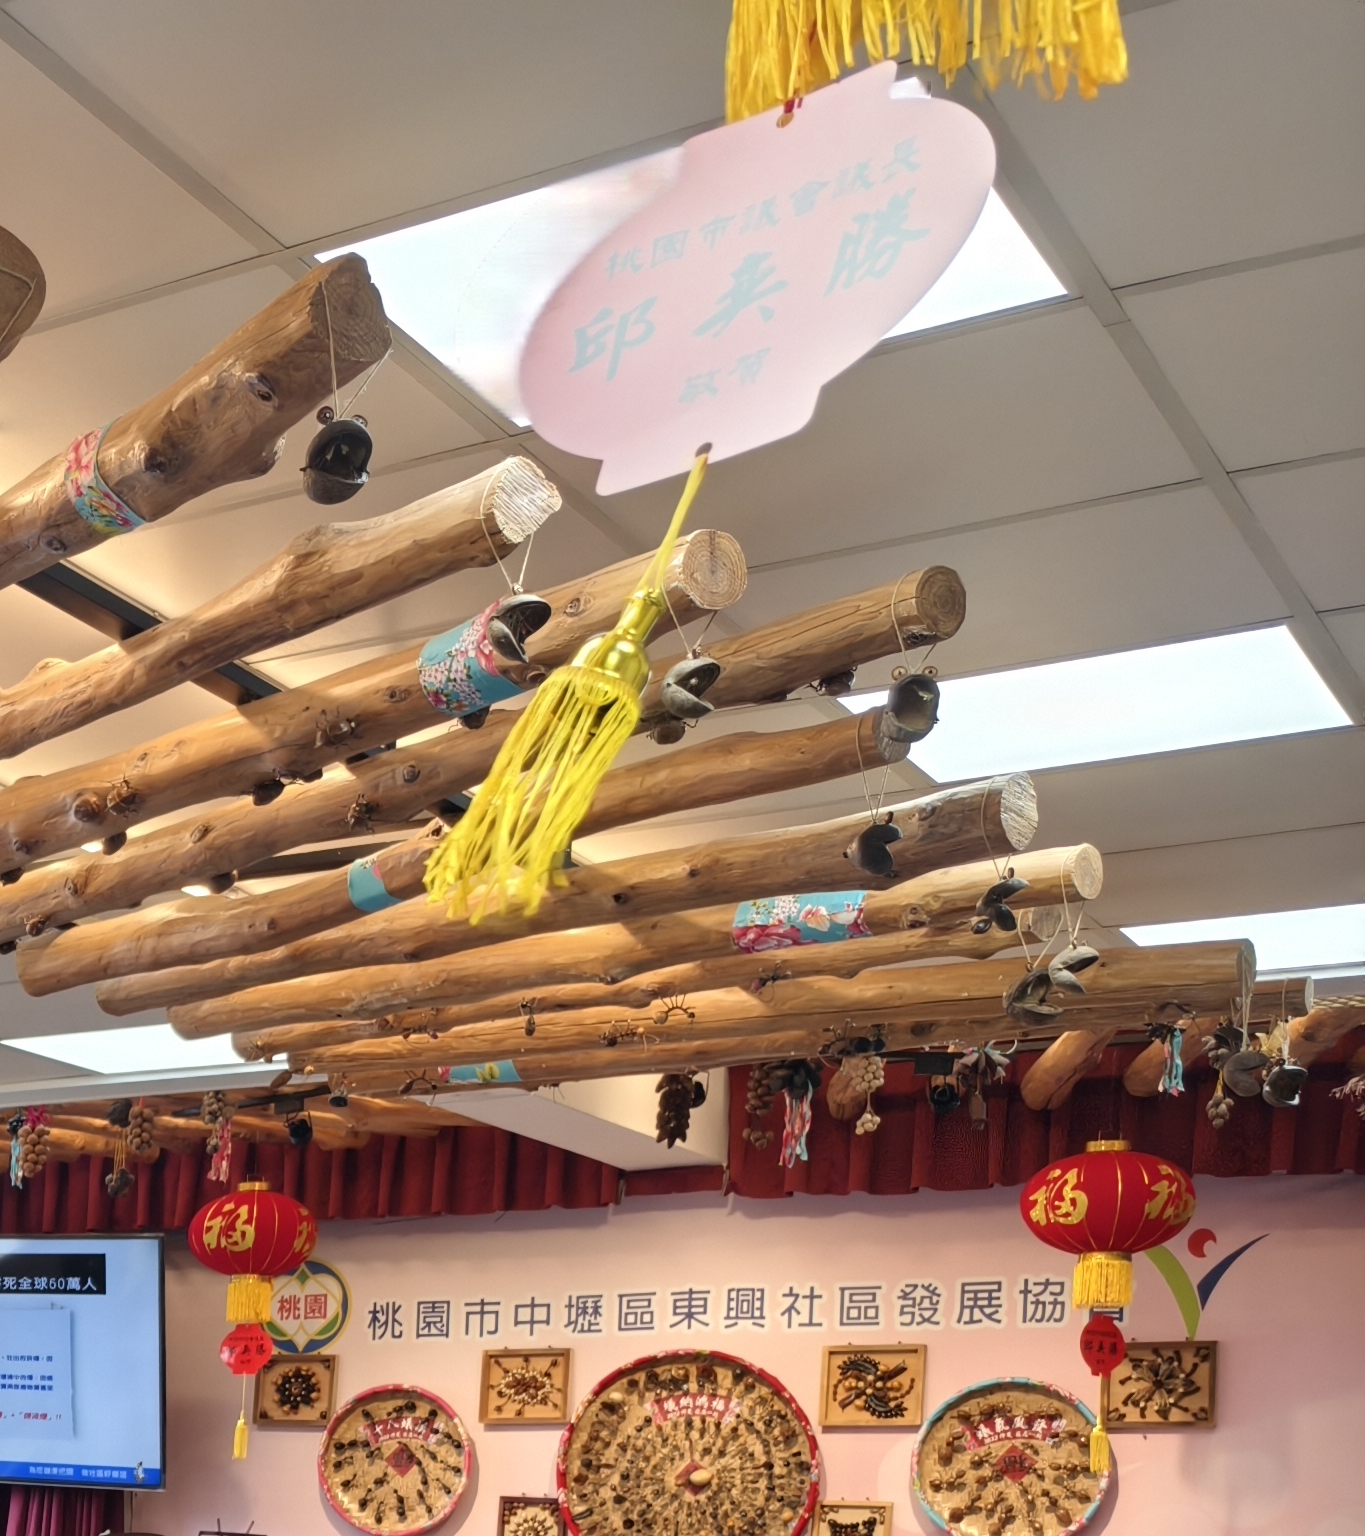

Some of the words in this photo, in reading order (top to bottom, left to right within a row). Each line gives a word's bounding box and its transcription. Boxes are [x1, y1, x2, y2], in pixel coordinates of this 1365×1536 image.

[1029, 1167, 1089, 1226] 福
[203, 1201, 255, 1252] 福
[277, 1293, 328, 1320] 桃園
[367, 1278, 1124, 1341] 桃園市中壢區東興社區發展協
